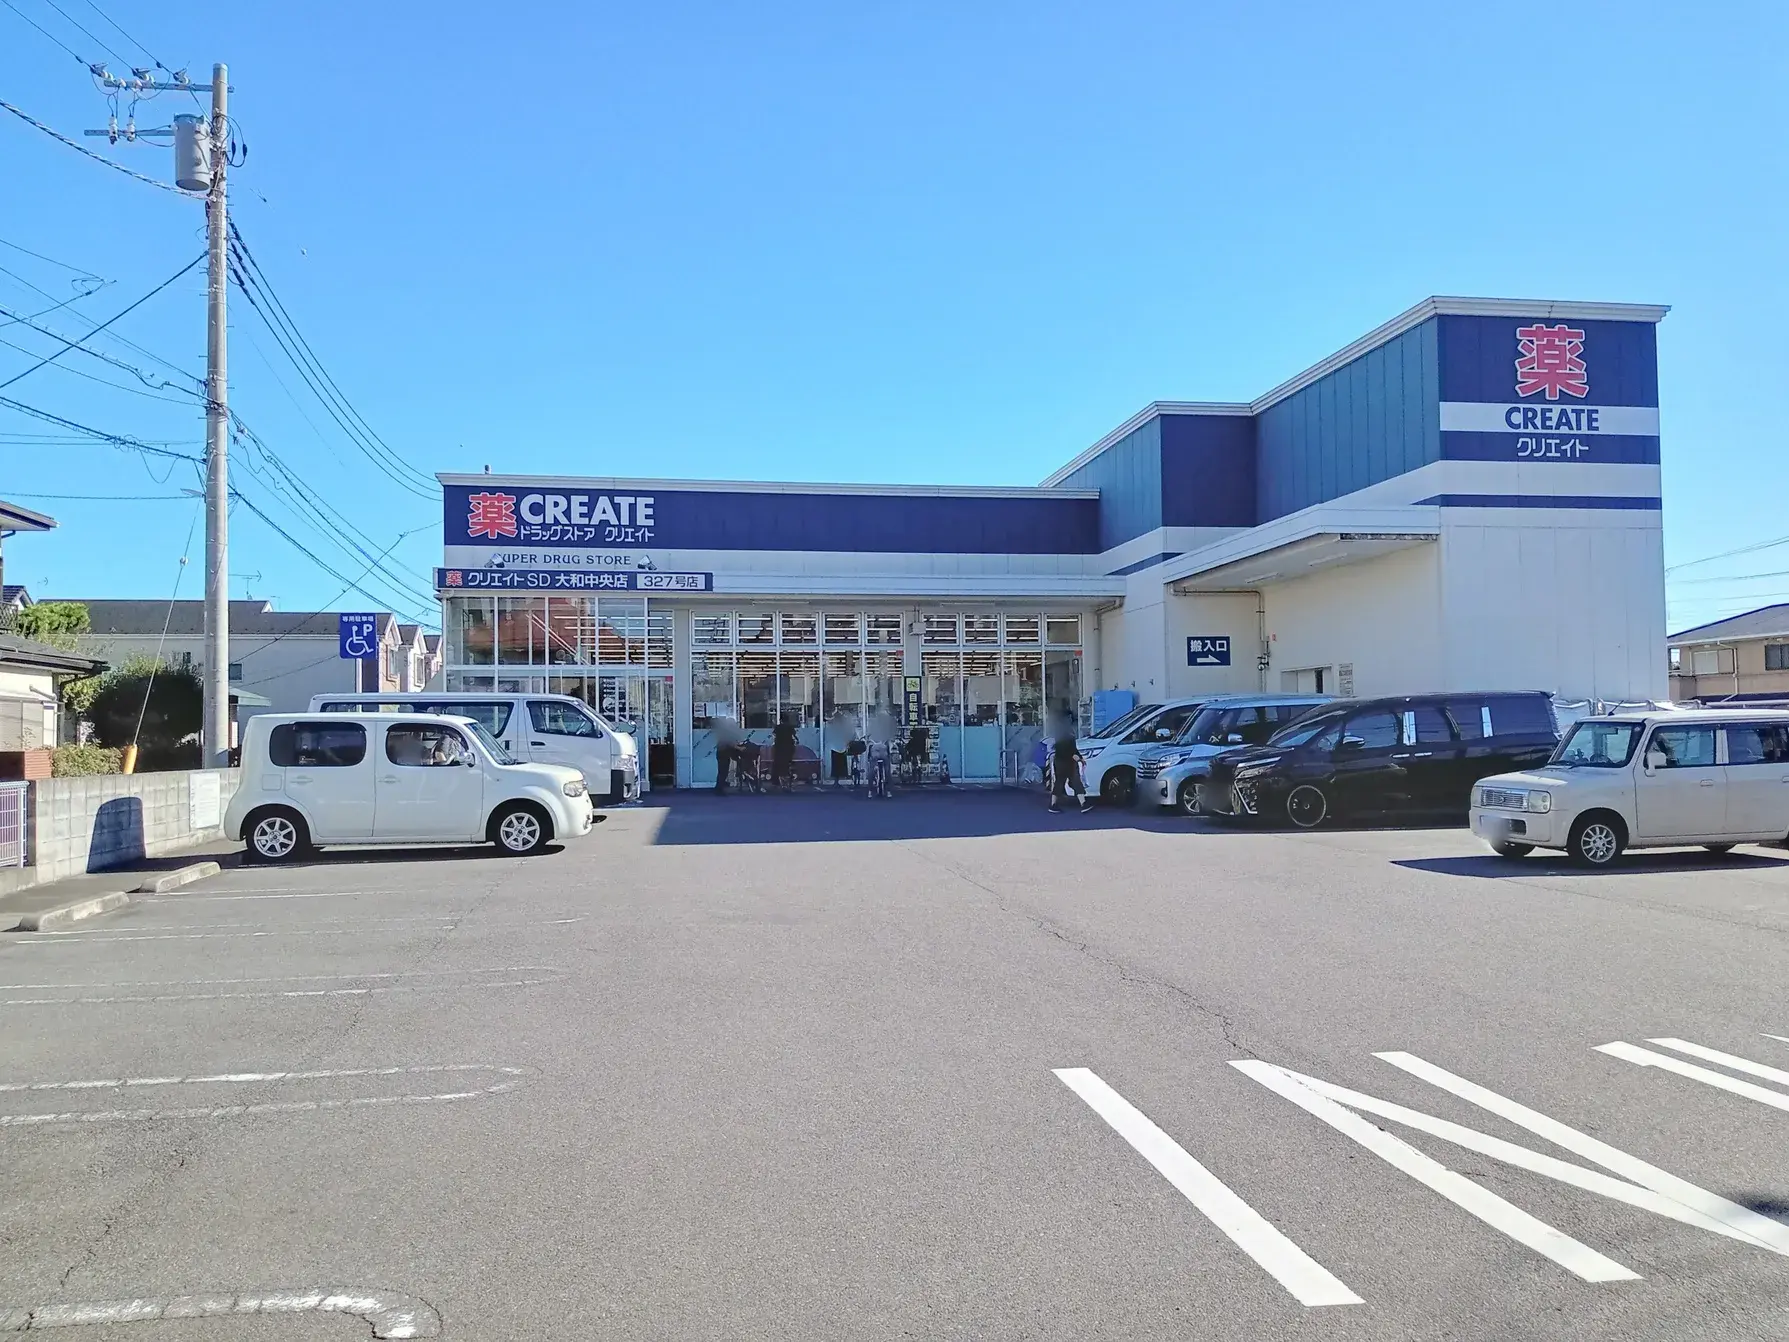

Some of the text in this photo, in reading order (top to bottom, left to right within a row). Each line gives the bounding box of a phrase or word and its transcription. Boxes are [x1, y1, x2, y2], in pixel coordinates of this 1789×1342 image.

[1514, 323, 1589, 400] 薬
[1505, 406, 1599, 431] CREATE
[1516, 437, 1589, 458] クリエイト
[467, 492, 518, 539] 薬
[519, 494, 655, 526] CREATE
[520, 525, 655, 543] ドラッグストア クリエイト
[500, 553, 632, 565] UPER DRUG STORE
[446, 570, 463, 587] 薬
[643, 575, 699, 588] 327号店
[363, 624, 373, 637] P
[1190, 639, 1227, 652] 搬入口
